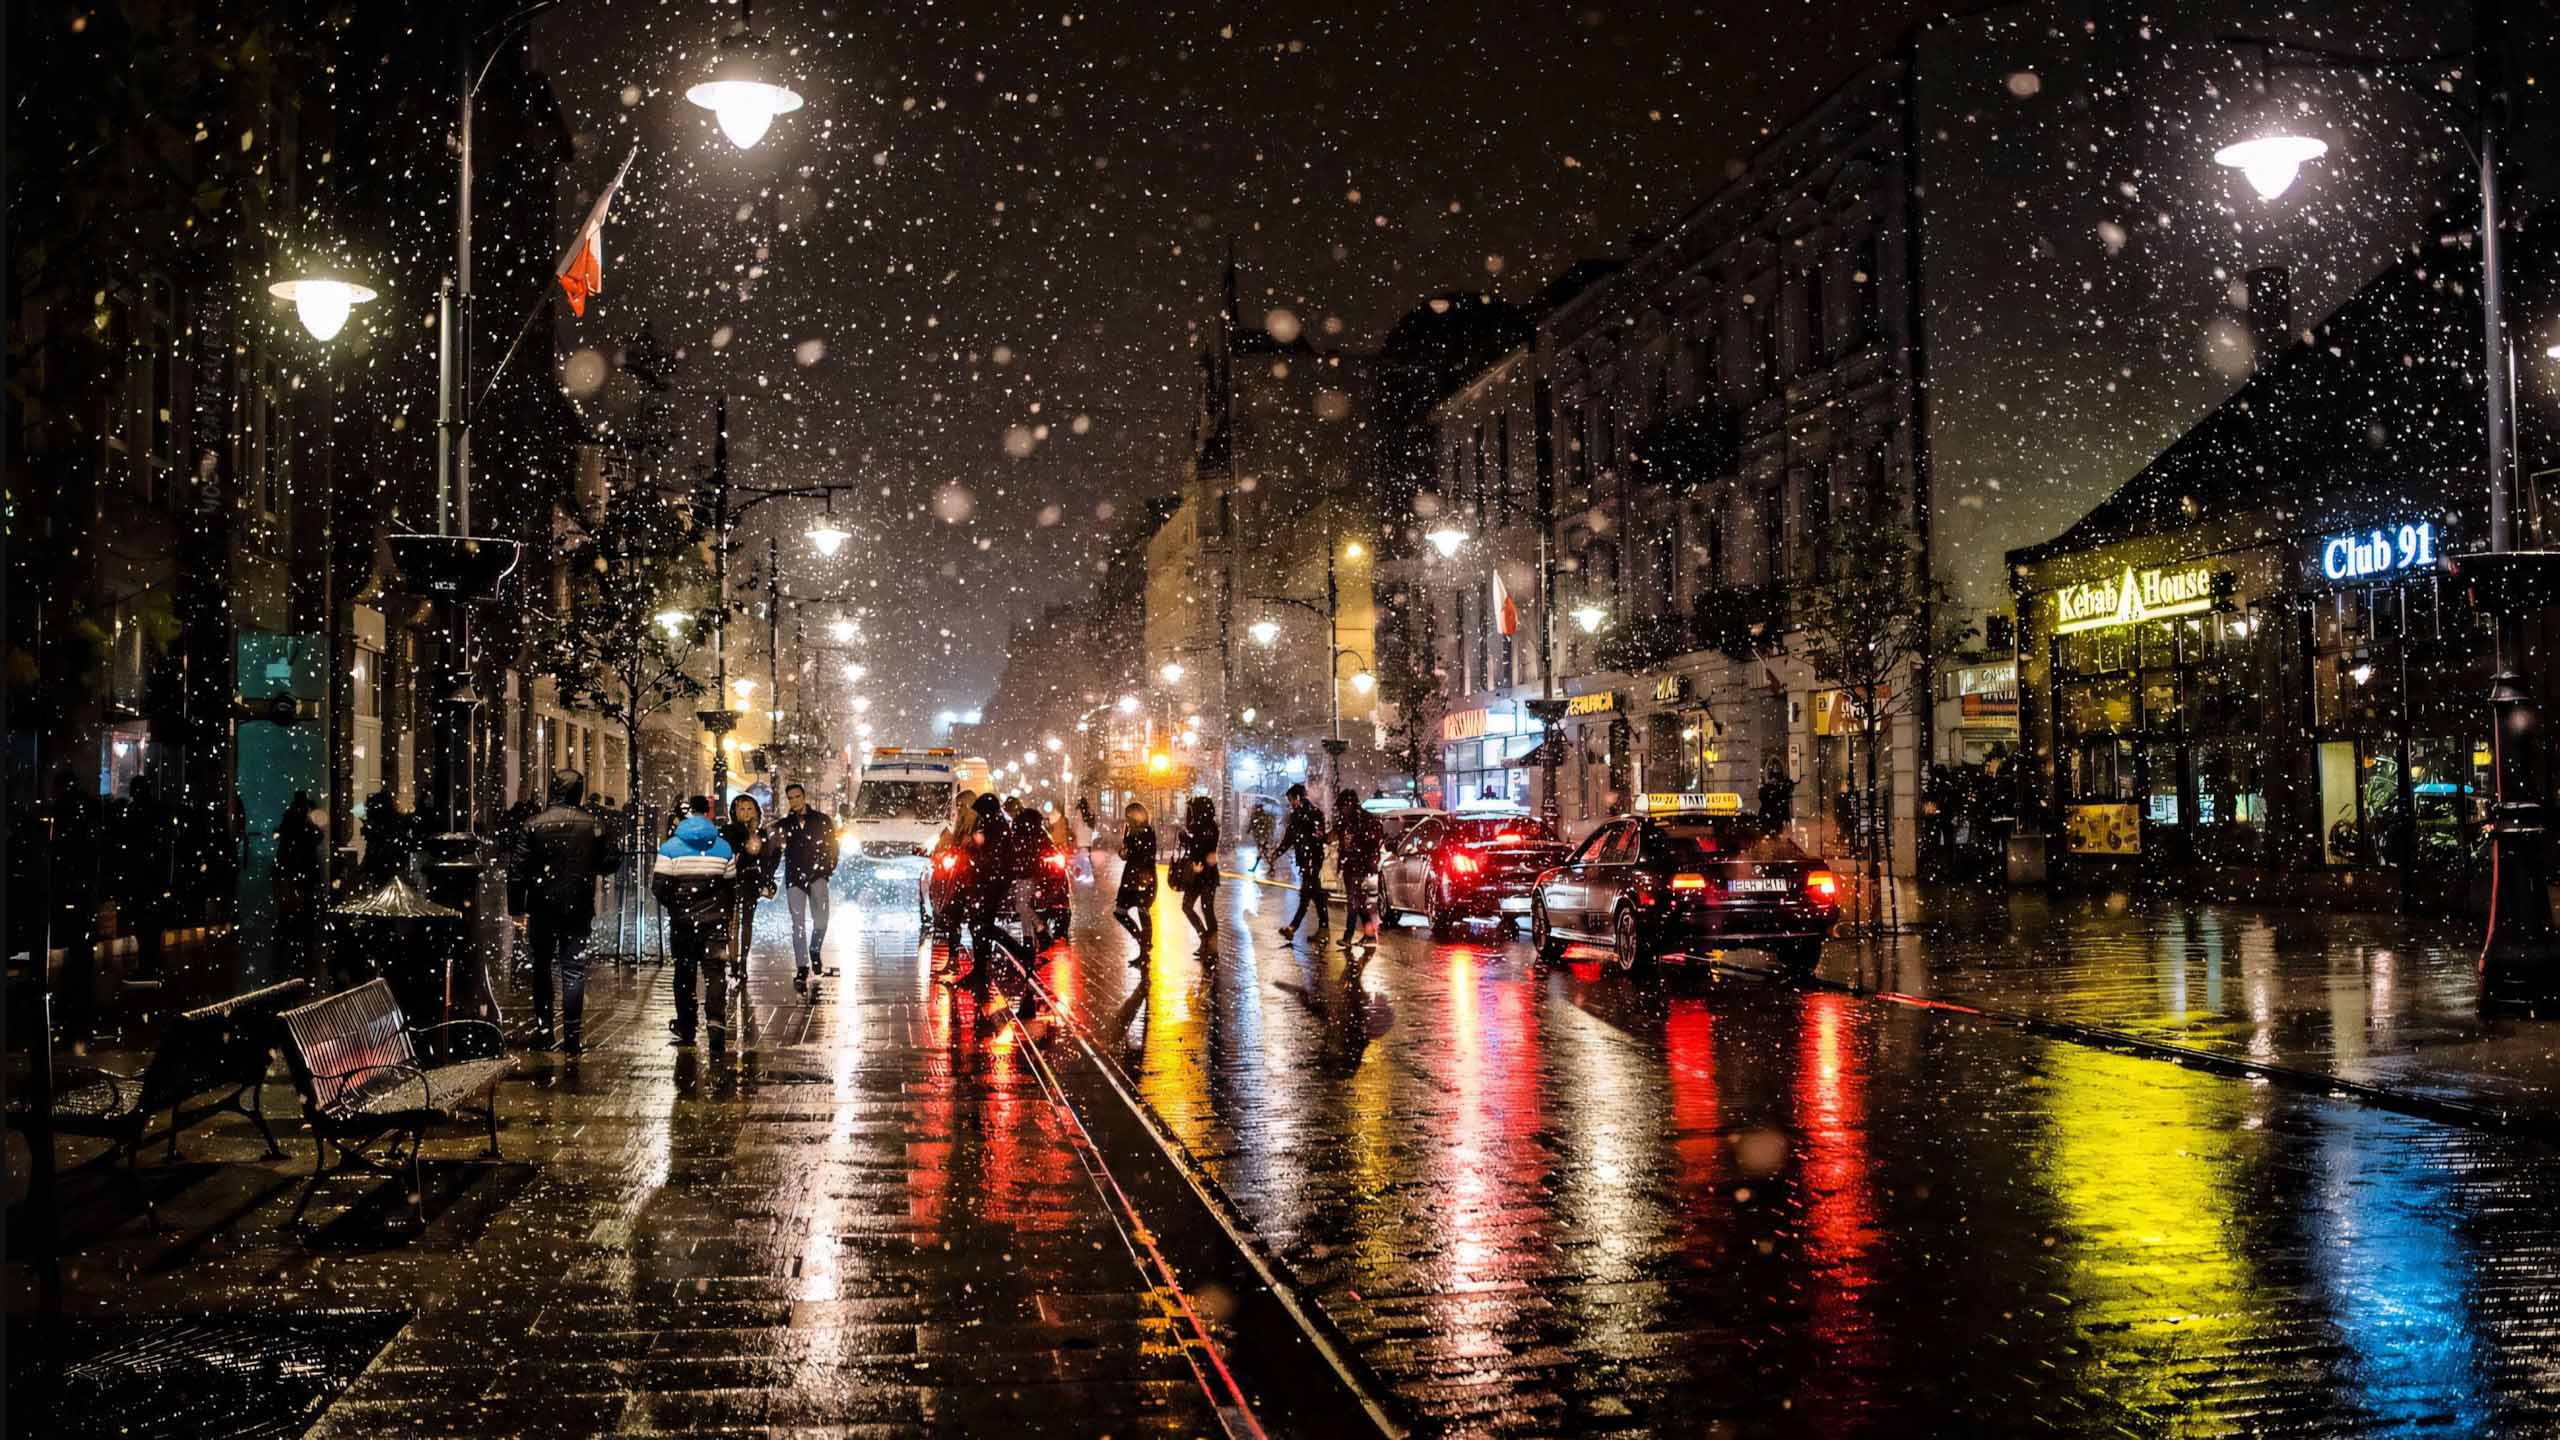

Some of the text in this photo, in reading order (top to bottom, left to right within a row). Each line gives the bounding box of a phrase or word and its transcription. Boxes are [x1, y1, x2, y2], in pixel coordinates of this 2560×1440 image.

[2325, 521, 2436, 579] Club 91
[2057, 569, 2210, 622] Kebab House
